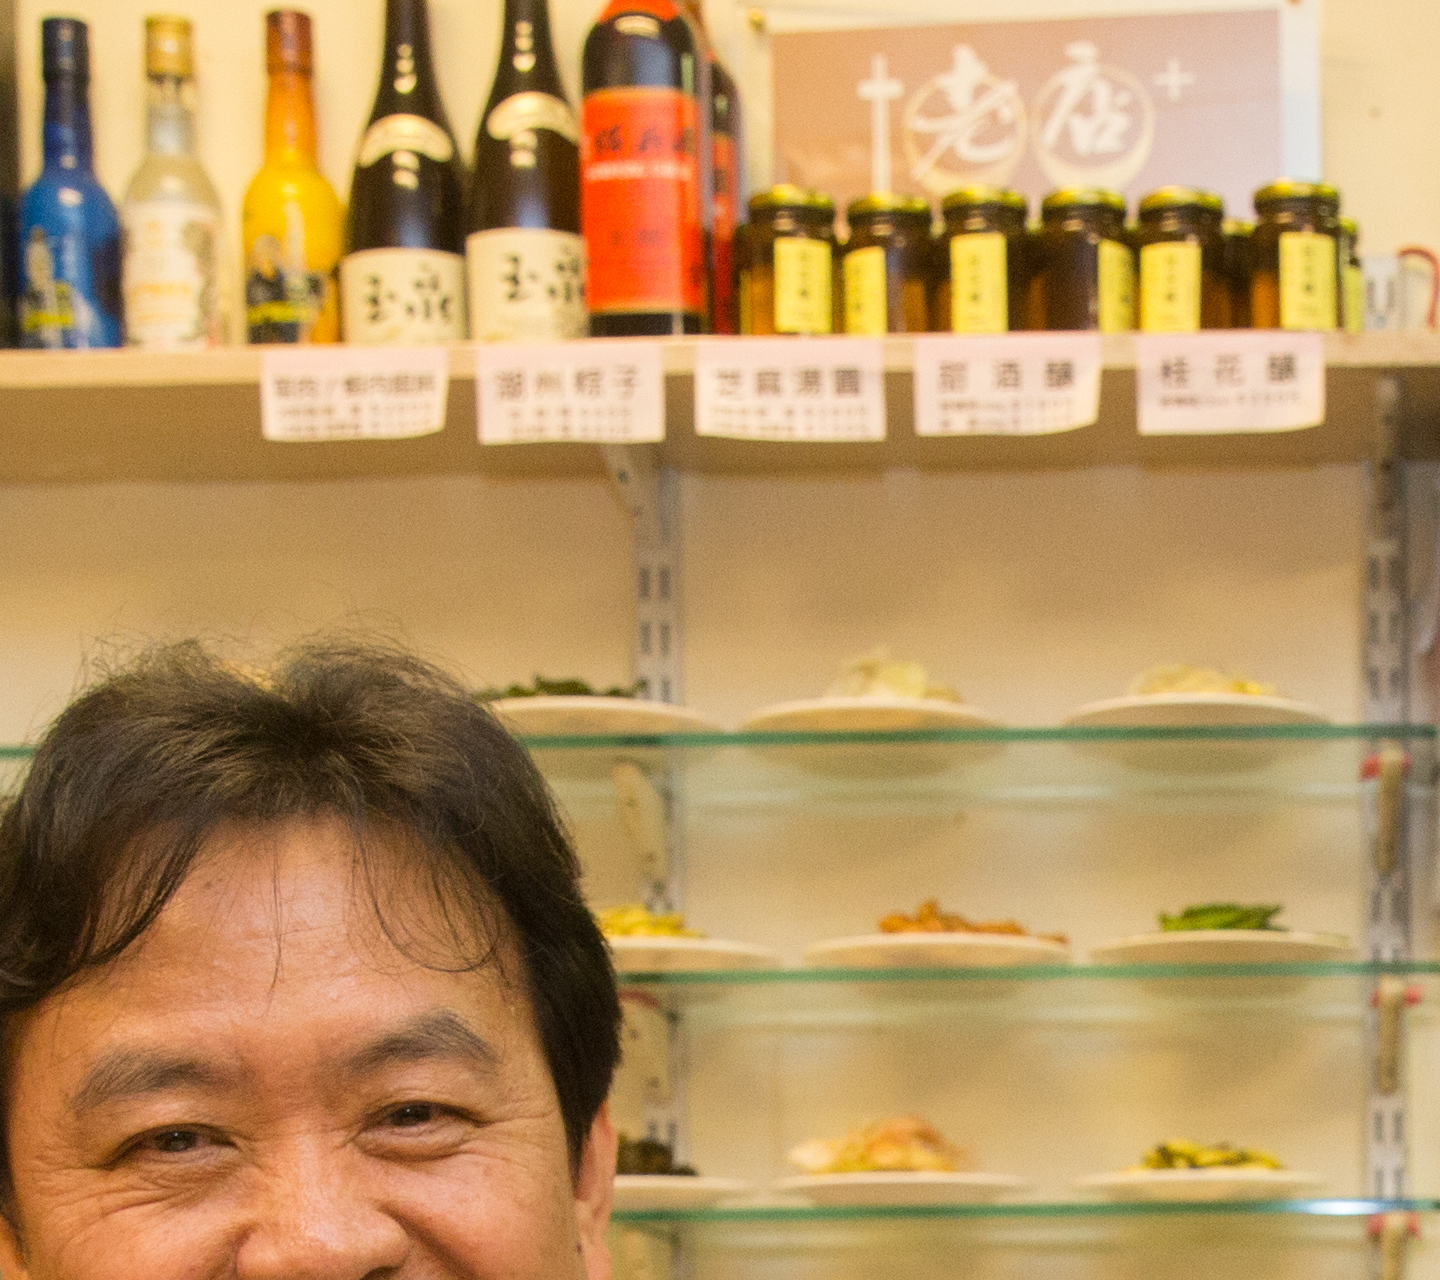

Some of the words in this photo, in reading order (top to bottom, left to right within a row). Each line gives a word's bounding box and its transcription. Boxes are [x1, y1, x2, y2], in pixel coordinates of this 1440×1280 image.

[913, 43, 1140, 178] 老店
[494, 366, 642, 401] 湖州粽子
[714, 368, 862, 400] 芝麻湯圓
[1160, 352, 1297, 388] 桂花釀
